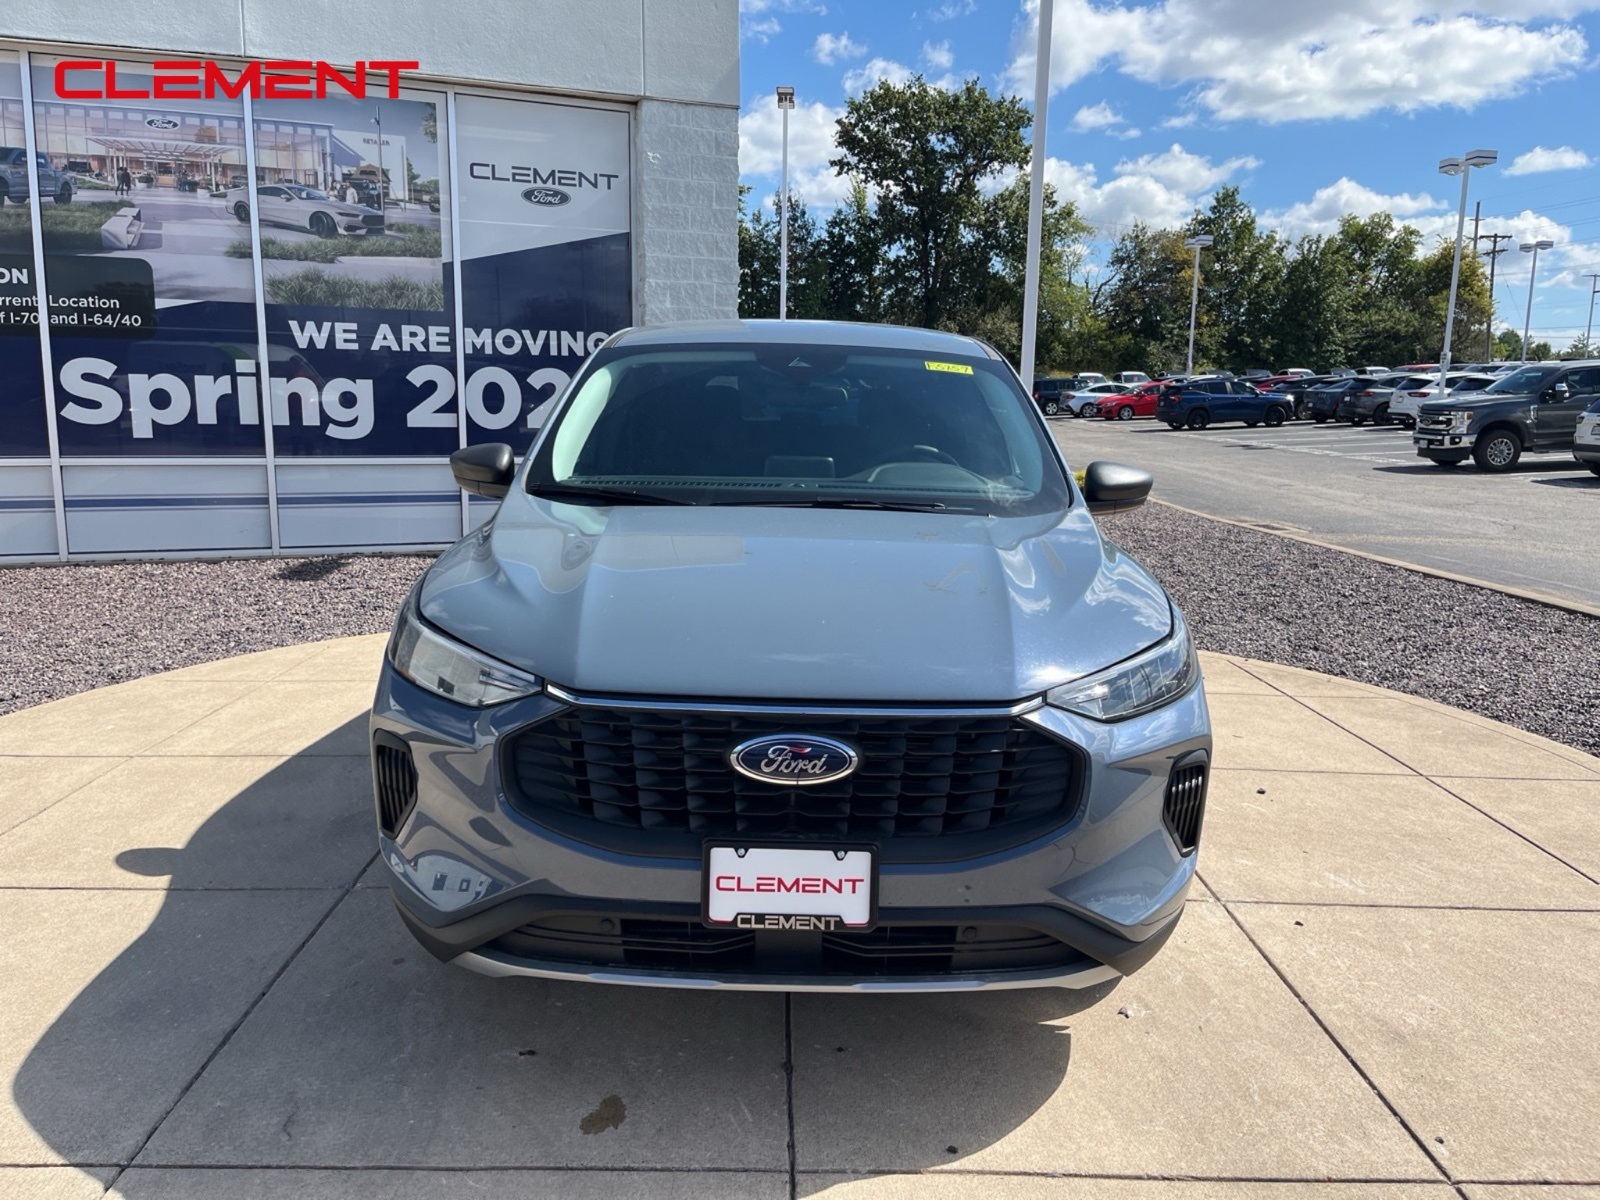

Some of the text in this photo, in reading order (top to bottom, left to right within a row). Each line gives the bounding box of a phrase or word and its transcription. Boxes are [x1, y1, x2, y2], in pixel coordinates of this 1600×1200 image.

[469, 162, 619, 190] CLEMENT
[531, 189, 561, 204] Ford
[48, 295, 120, 308] Location
[10, 312, 40, 324] I-70
[50, 313, 78, 324] and
[83, 313, 142, 327] I-64/40
[288, 319, 610, 357] WE ARE MOVING
[59, 356, 375, 440] Spring
[760, 745, 828, 774] Ford
[715, 875, 865, 894] CLEMENT
[736, 914, 840, 931] CLEMENT
